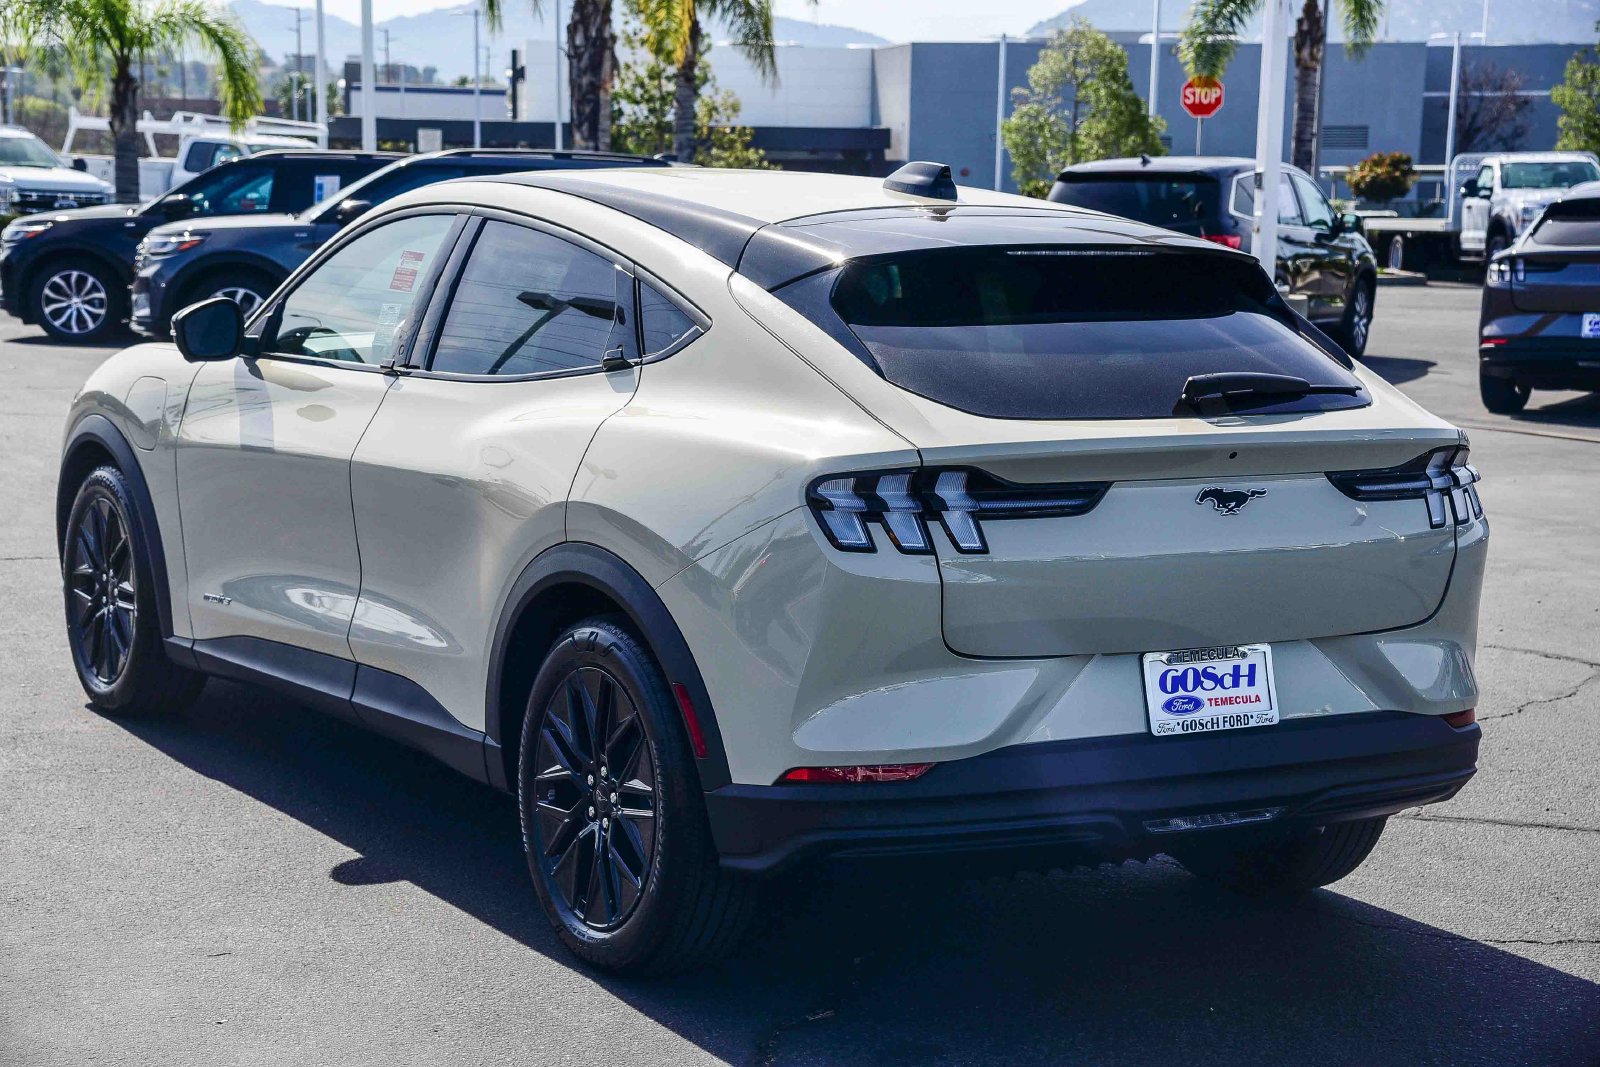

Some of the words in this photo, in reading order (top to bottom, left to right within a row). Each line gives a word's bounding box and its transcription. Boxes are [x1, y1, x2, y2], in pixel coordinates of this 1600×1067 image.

[1184, 87, 1221, 105] STOP
[1174, 647, 1240, 663] TEMECULA
[1171, 699, 1195, 711] Ford
[1207, 694, 1262, 707] TEMECULA
[1222, 714, 1250, 728] FORD
